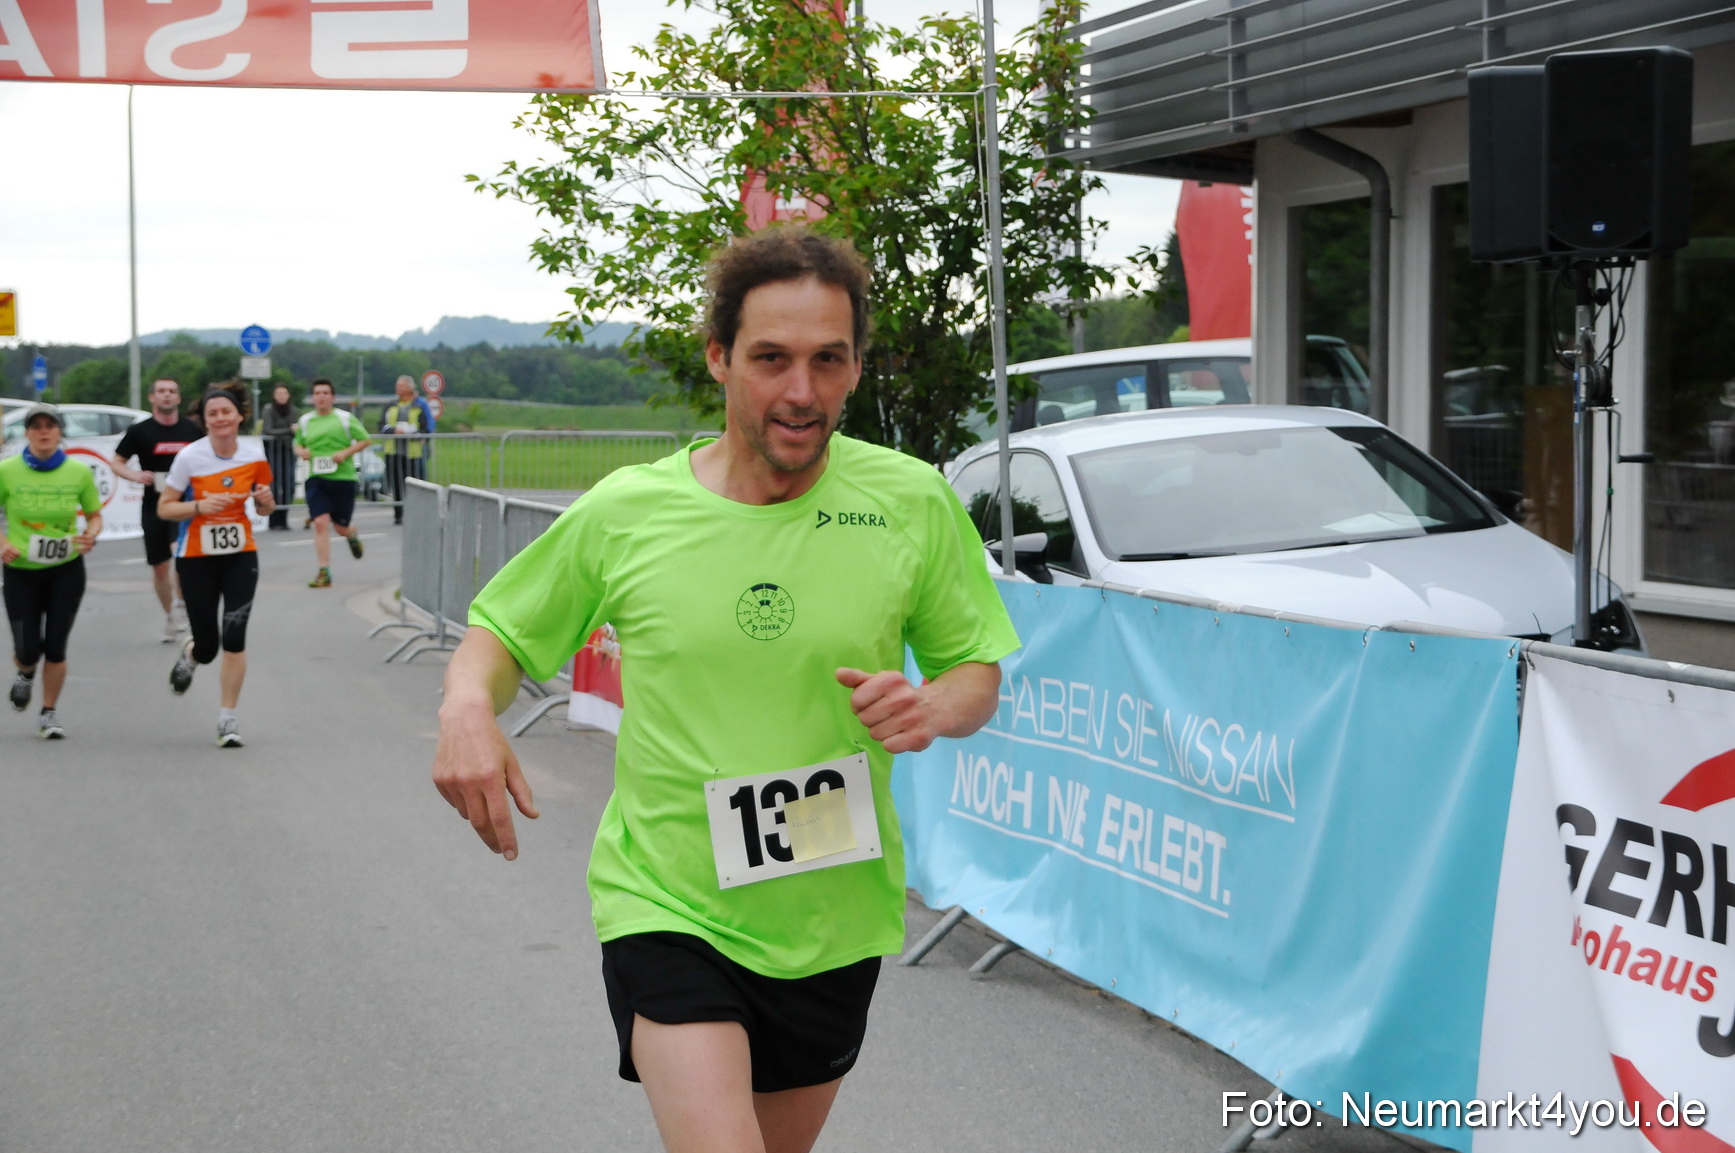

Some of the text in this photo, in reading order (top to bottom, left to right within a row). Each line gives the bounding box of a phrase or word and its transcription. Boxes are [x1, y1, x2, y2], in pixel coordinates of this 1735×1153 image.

[838, 512, 887, 528] DEKRA
[210, 526, 239, 549] 133
[38, 539, 69, 559] 109
[777, 598, 785, 606] 10
[997, 673, 1296, 810] HABEN SIE NISSAN
[951, 749, 1231, 906] NOCH NIE ERLEBT.
